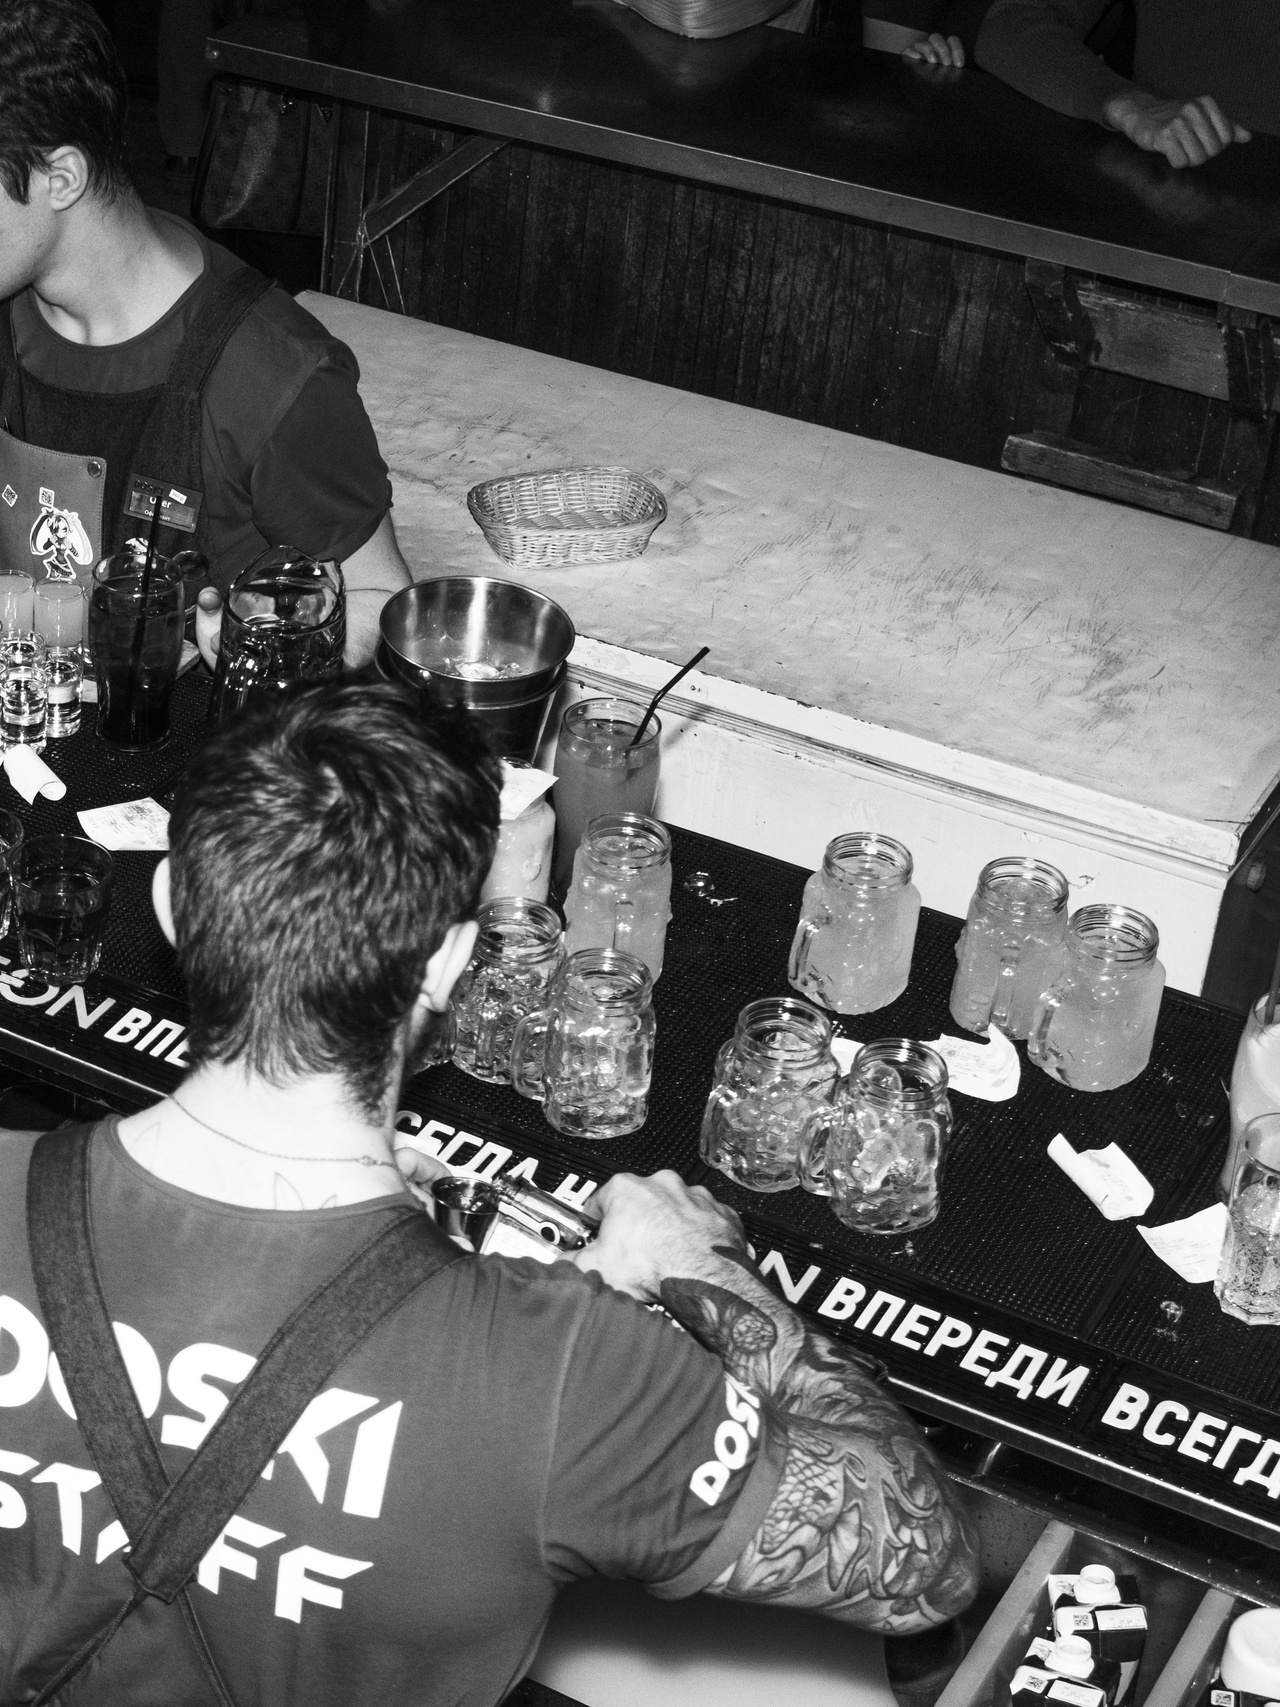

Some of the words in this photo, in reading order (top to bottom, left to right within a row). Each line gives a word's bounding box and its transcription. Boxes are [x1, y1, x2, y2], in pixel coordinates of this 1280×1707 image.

[394, 1109, 540, 1190] СЕГДА
[551, 1172, 598, 1212] Н
[817, 1276, 1090, 1408] ВПЕРЕДИ
[689, 1372, 760, 1506] DOS
[1100, 1382, 1280, 1500] ВСЕГД
